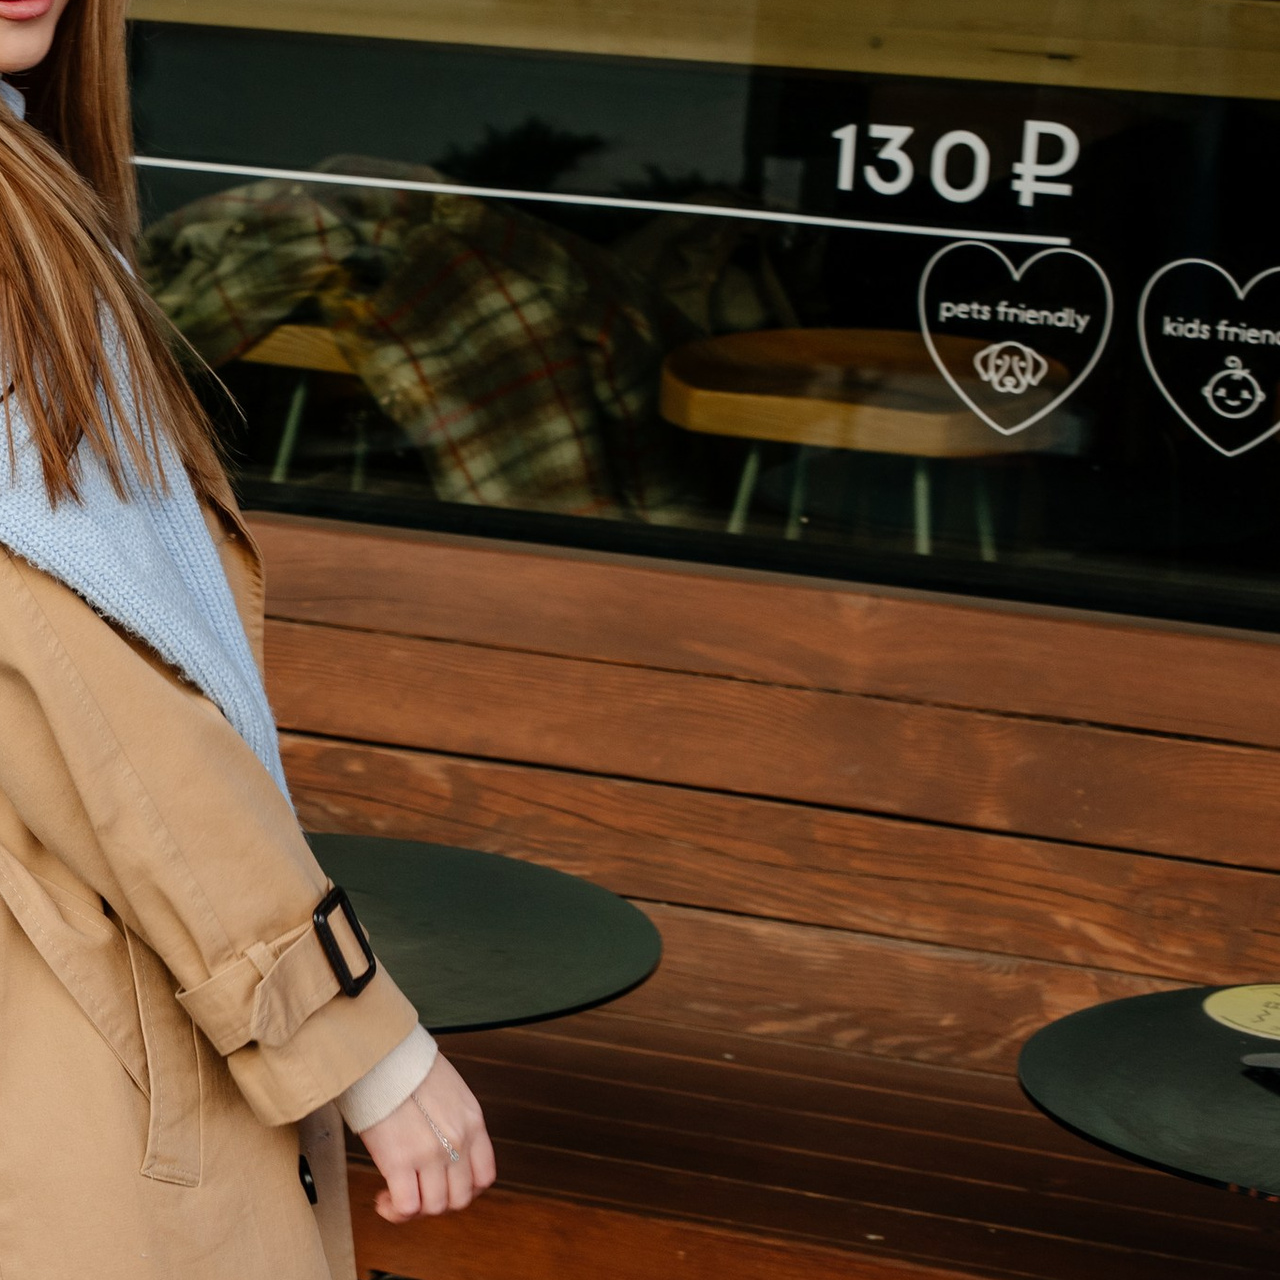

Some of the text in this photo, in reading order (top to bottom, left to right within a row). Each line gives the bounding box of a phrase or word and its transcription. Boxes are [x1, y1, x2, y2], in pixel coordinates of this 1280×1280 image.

[938, 300, 1091, 335] pets friendly
[1162, 316, 1212, 341] kids
